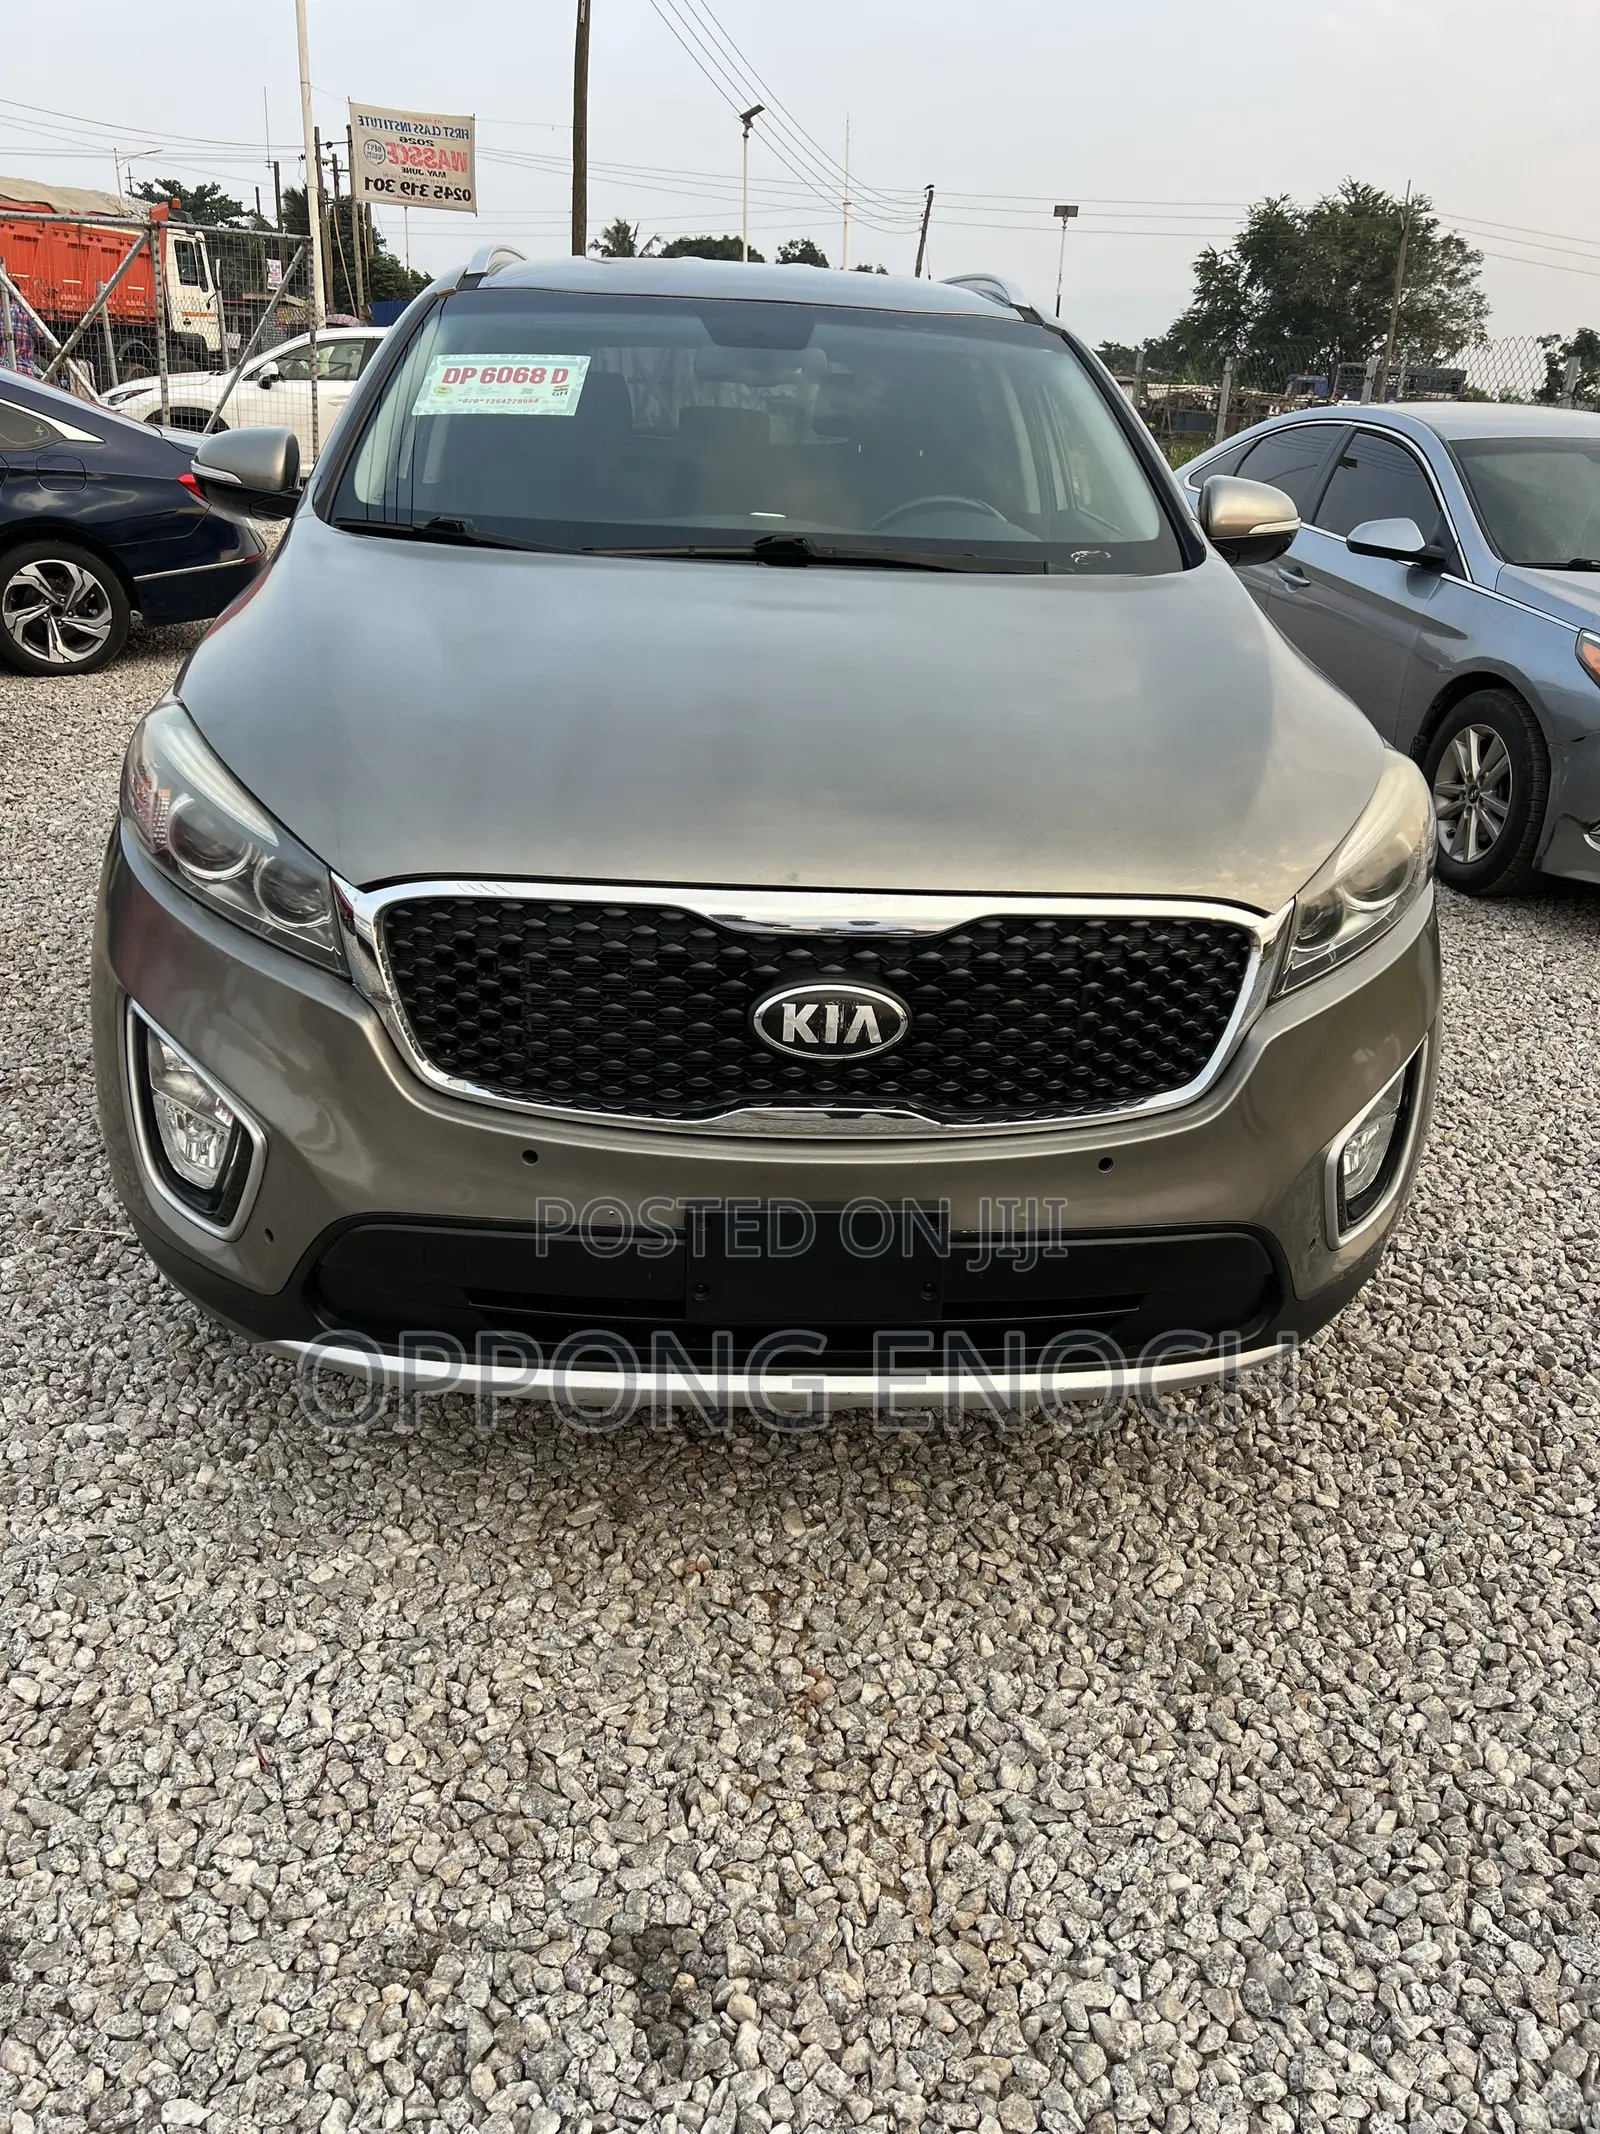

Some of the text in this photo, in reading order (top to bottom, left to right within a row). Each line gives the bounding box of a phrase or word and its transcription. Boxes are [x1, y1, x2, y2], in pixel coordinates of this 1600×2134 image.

[442, 366, 569, 385] DP 6068 D
[782, 1003, 882, 1044] KIA
